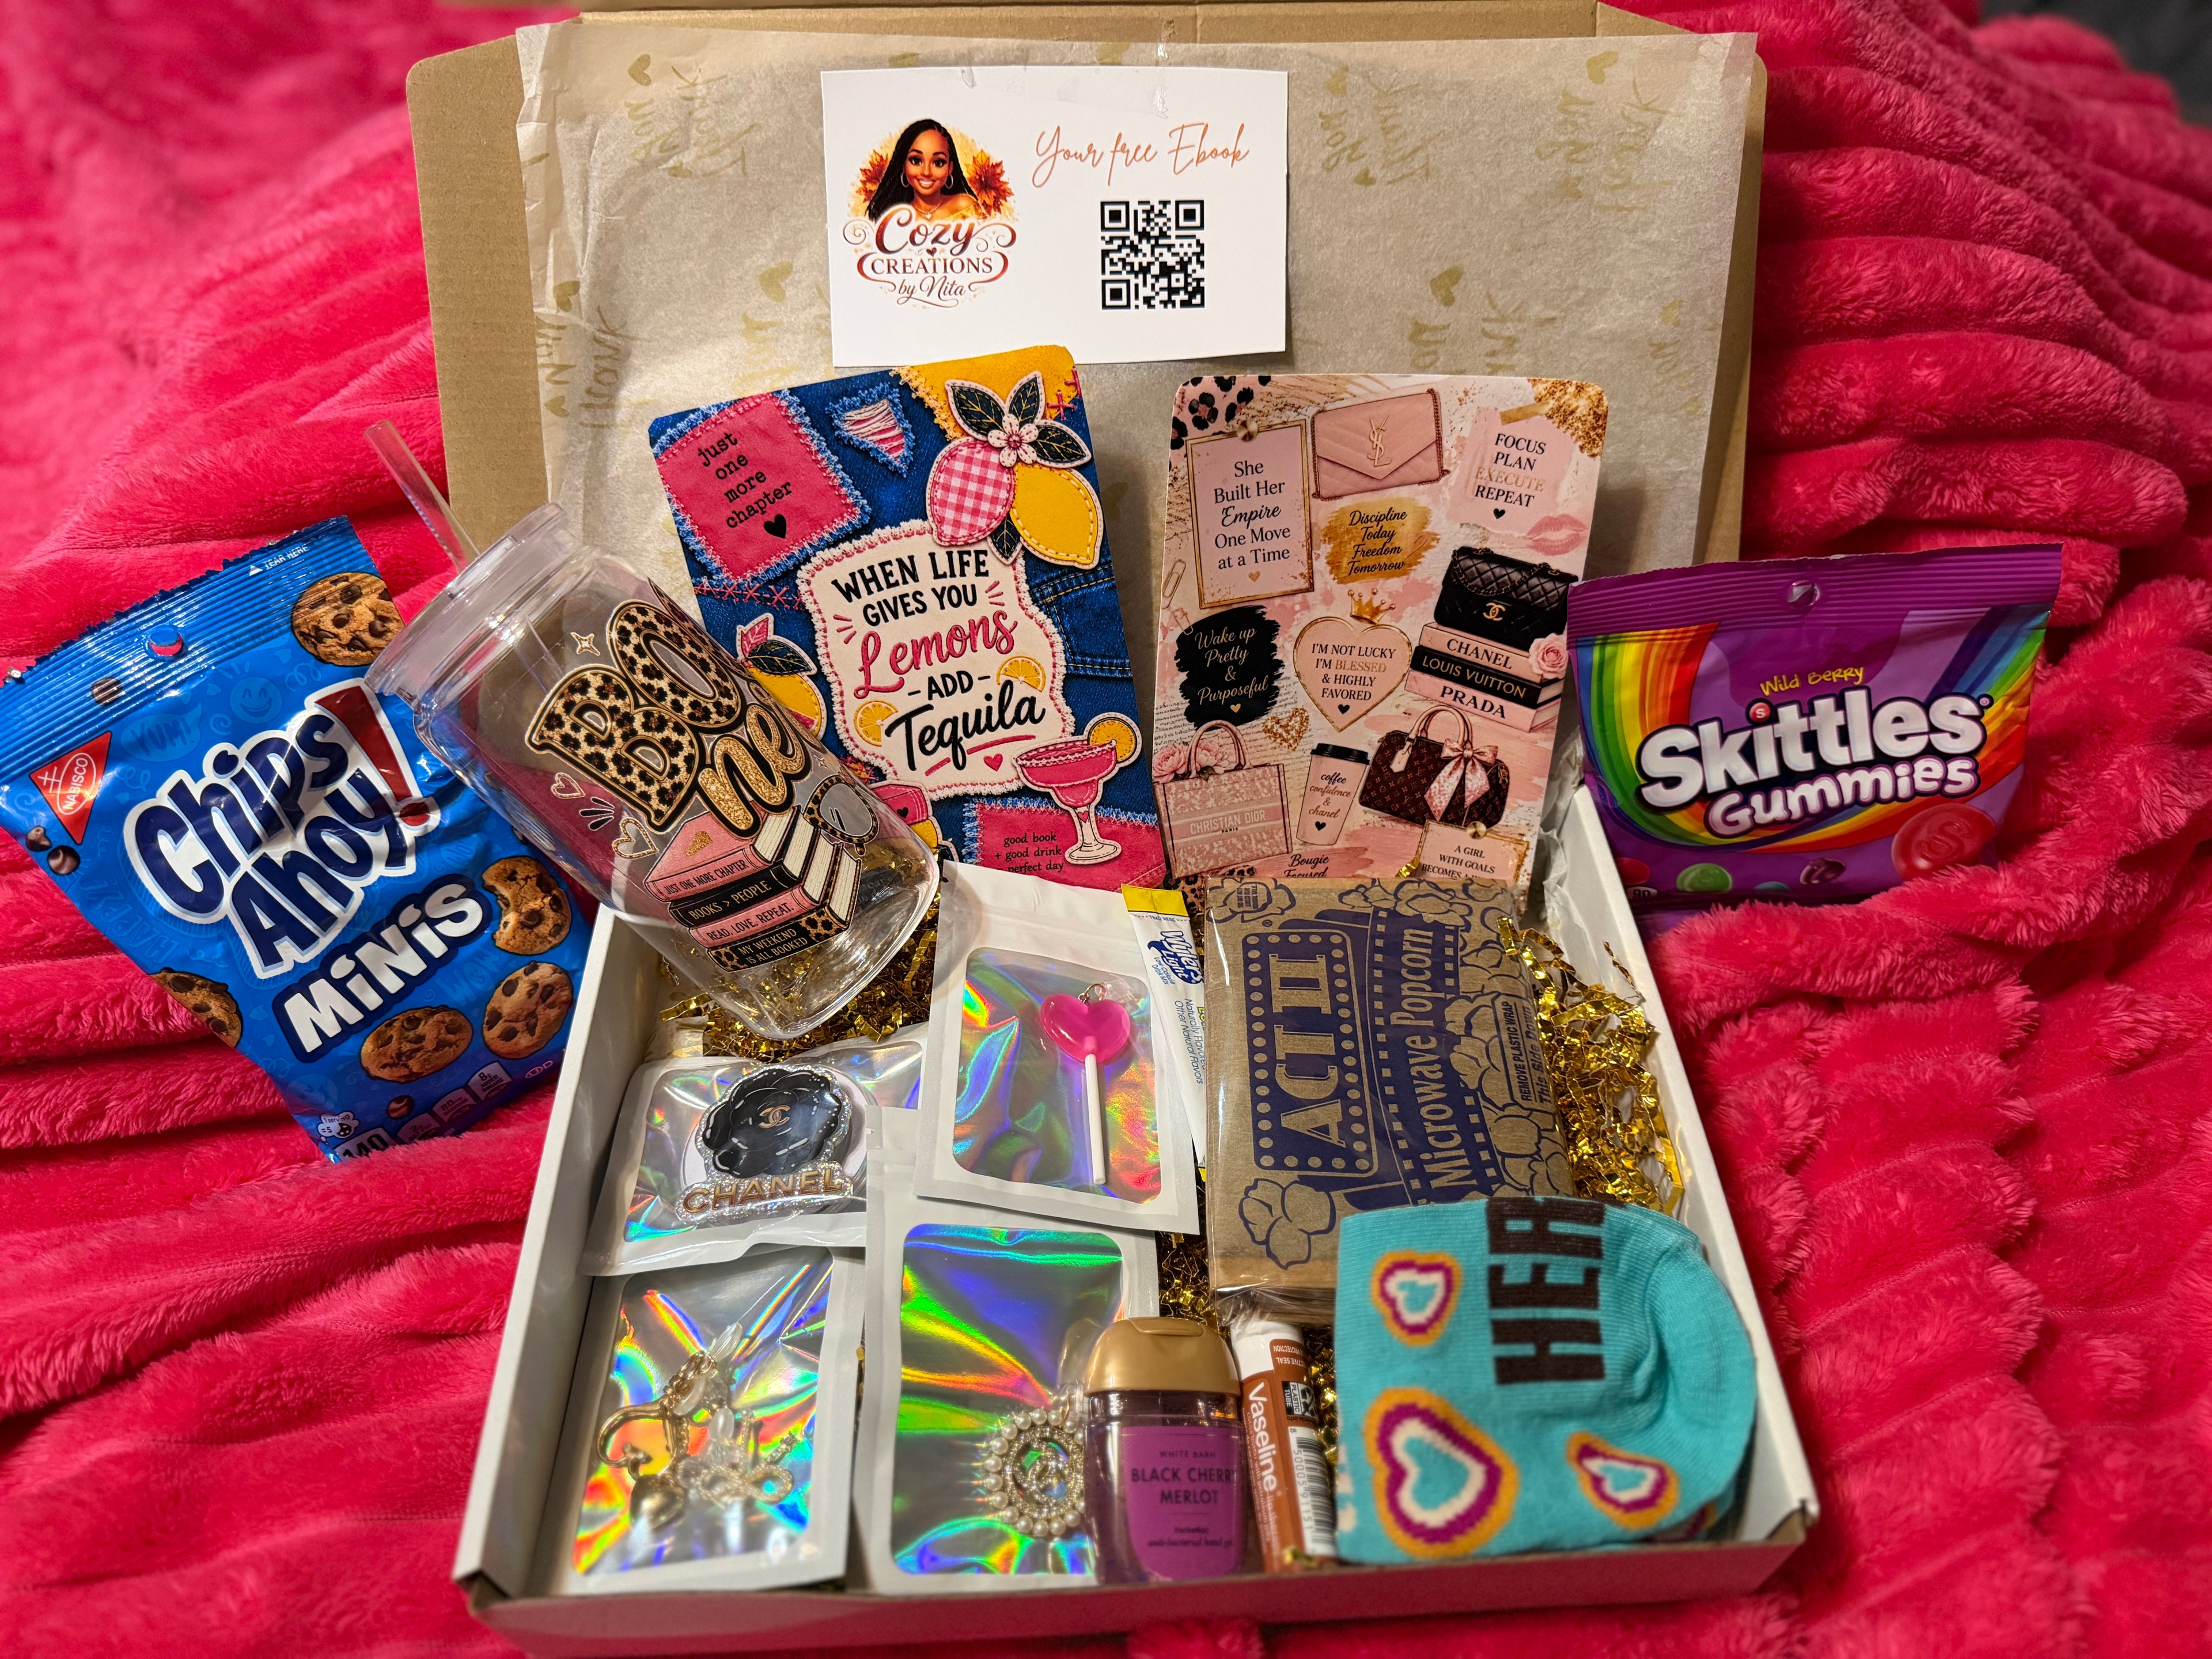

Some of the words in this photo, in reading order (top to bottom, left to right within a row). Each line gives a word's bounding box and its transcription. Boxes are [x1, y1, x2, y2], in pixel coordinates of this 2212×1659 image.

[1032, 124, 1108, 188] Your
[1107, 132, 1158, 187] free
[1168, 122, 1251, 176] Ebook
[876, 203, 983, 257] Cozy
[871, 257, 993, 275] CREATIONS
[893, 278, 917, 305] by
[919, 275, 966, 298] Nita
[698, 430, 738, 468] just
[1495, 433, 1547, 455] FOCUS
[715, 452, 748, 480] one
[1234, 460, 1264, 478] She
[1493, 452, 1537, 471] PLAN
[725, 470, 767, 502] more
[1475, 467, 1546, 492] EXECUTE
[1214, 484, 1251, 504] Built
[1256, 480, 1286, 497] Her
[1475, 485, 1535, 507] REPEAT
[726, 480, 793, 529] chapter
[1221, 505, 1282, 529] Empire
[1349, 507, 1407, 527] Discipline
[1215, 533, 1246, 548] One
[1251, 527, 1291, 544] Move
[1361, 525, 1396, 544] Today
[263, 554, 286, 570] TEAR
[286, 546, 309, 559] HERE
[1218, 556, 1233, 570] at
[1238, 555, 1246, 566] a
[1250, 548, 1290, 564] Time
[1351, 541, 1402, 560] Freedom
[831, 556, 925, 603] WHEN
[931, 549, 990, 579] LIFE
[1347, 560, 1406, 576] Tomorrow
[862, 590, 927, 627] GIVES
[930, 585, 978, 610] YOU
[1194, 627, 1235, 650] Wake
[1238, 627, 1257, 642] up
[854, 610, 1018, 699] Lemons
[1205, 645, 1249, 667] Pretty
[1312, 643, 1328, 654] I'M
[1331, 645, 1355, 656] NOT
[1358, 646, 1396, 659] LUCKY
[1447, 639, 1512, 670] CHANEL
[1225, 665, 1237, 681] &
[1316, 658, 1332, 669] I'M
[1335, 660, 1387, 673] BLESSED
[1423, 656, 1463, 677] LOUIS
[1466, 669, 1527, 699] VUITTON
[1198, 675, 1269, 705] Purposeful
[1322, 673, 1330, 684] &
[1334, 675, 1376, 687] HIGHLY
[1760, 674, 1800, 696] Wild
[1321, 688, 1372, 701] FAVORED
[1440, 685, 1506, 719] PRADA
[885, 681, 1047, 772] Tequila
[1641, 687, 1983, 808] Skittles
[64, 757, 88, 809] NABISCO
[1320, 772, 1347, 785] coffee
[1309, 784, 1351, 798] confidence
[1323, 797, 1331, 806] &
[1705, 757, 1979, 838] Gummies
[134, 714, 349, 903] Chips
[1308, 806, 1339, 819] chanel
[1190, 814, 1241, 835] CHRISTIAN
[1245, 810, 1266, 824] DIOR
[1003, 833, 1028, 847] good
[1033, 831, 1057, 842] book
[1006, 847, 1029, 862] good
[1034, 845, 1062, 857] drink
[1288, 854, 1329, 869] Bougie
[1440, 854, 1463, 866] WITH
[1465, 860, 1495, 874] GOALS
[1463, 847, 1486, 859] GIRL
[664, 883, 681, 895] JUST
[681, 879, 696, 891] ONE
[696, 872, 716, 886] MORE
[716, 859, 750, 878] CHAPTER
[1007, 862, 1041, 874] perfect
[1046, 860, 1064, 873] day
[688, 902, 723, 921] BOOKS
[730, 880, 772, 904] PEOPLE
[1633, 889, 1651, 899] 90
[756, 902, 794, 923] REPEAT.
[737, 945, 755, 956] MY
[753, 929, 797, 949] WEEKEND
[747, 956, 756, 964] IS
[757, 951, 773, 963] ALL
[773, 937, 808, 956] BOOKED
[1152, 964, 1162, 976] Drink
[1154, 957, 1162, 967] Low
[1161, 950, 1189, 979] Light
[1270, 953, 1332, 1015] II
[1389, 928, 1437, 1027] Popcorn
[1184, 998, 1200, 1035] Naturally
[1501, 1001, 1516, 1025] WRAP
[1175, 1000, 1186, 1023] Other
[1182, 1025, 1194, 1057] Natural
[1191, 1056, 1203, 1085] Flavors
[1506, 1027, 1525, 1062] PLASTIC
[1529, 1044, 1544, 1073] Side
[1273, 1025, 1346, 1149] ACT
[1515, 1063, 1533, 1102] REMOVE
[1536, 1076, 1552, 1104] This
[1411, 1033, 1464, 1191] Microwave
[683, 1169, 844, 1215] CHANEL
[1291, 1384, 1300, 1412] PLASTIC
[1249, 1382, 1279, 1491] Vaseline
[1131, 1468, 1181, 1483] BLACK
[1160, 1490, 1219, 1505] MERLOT
